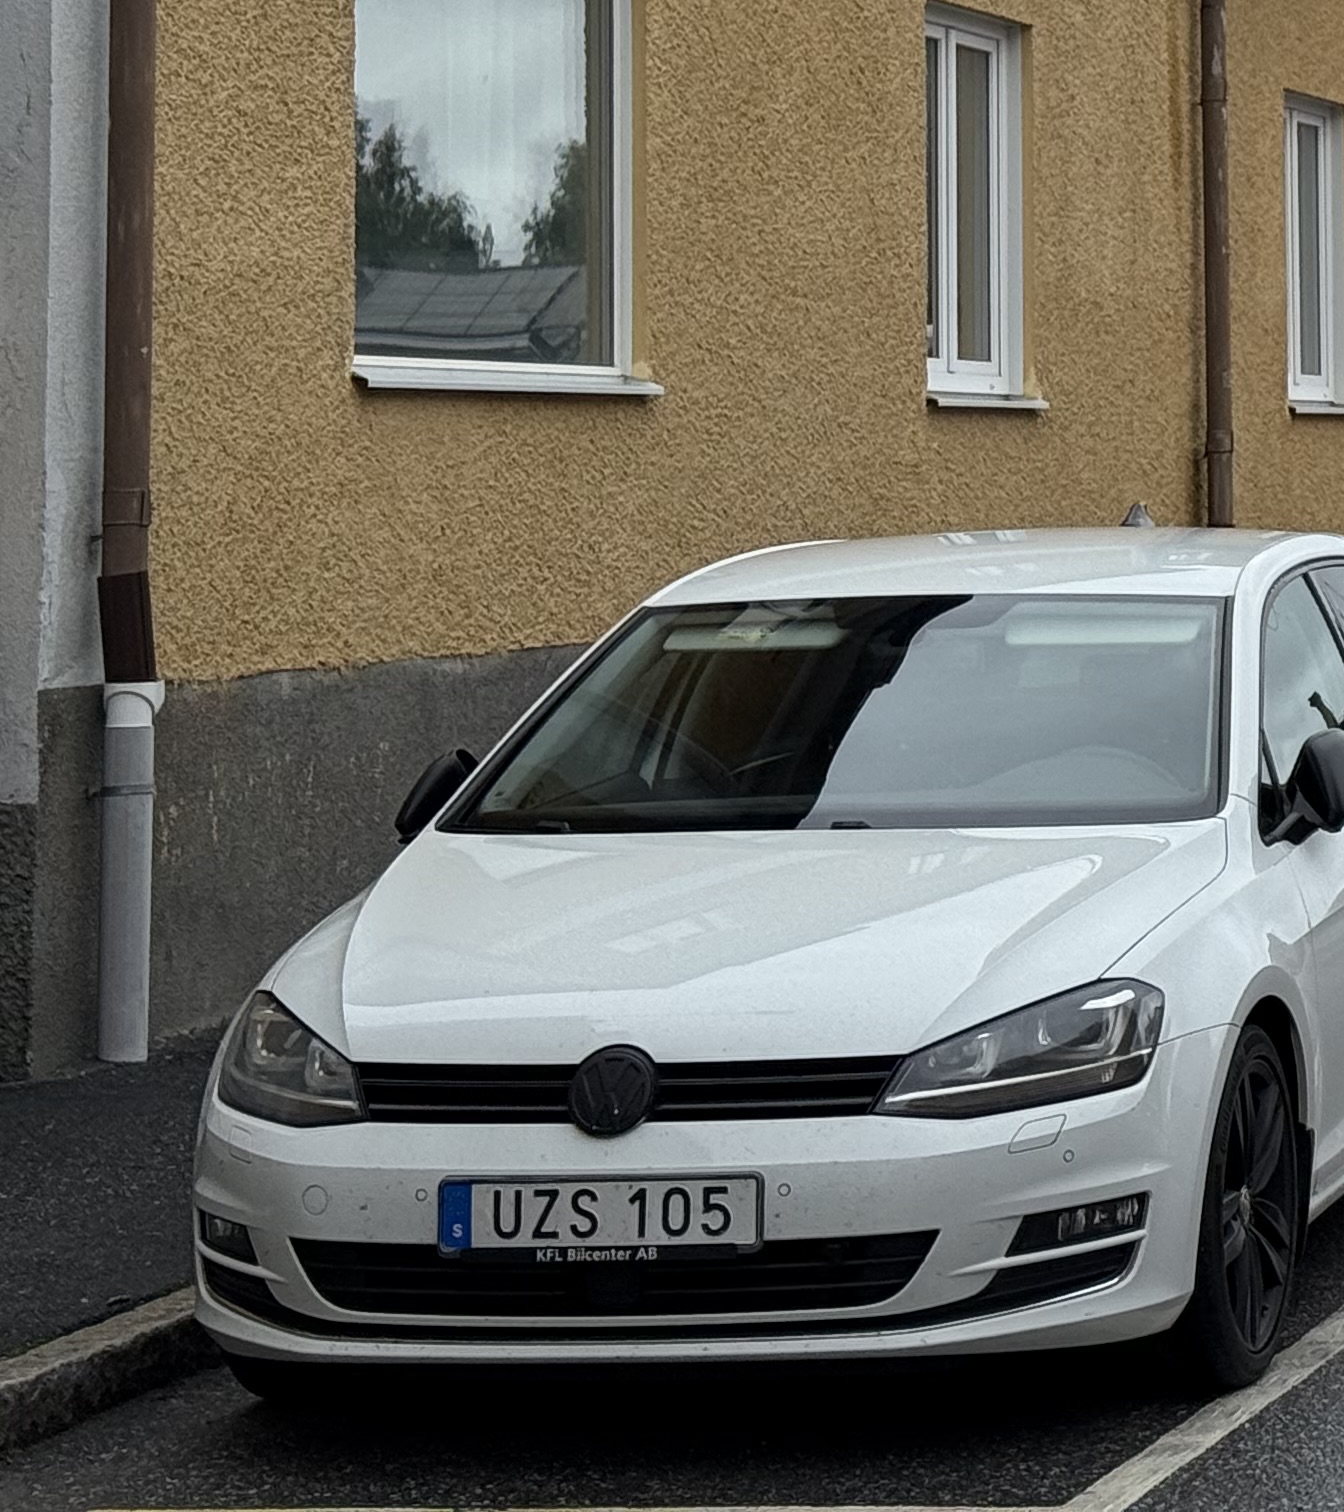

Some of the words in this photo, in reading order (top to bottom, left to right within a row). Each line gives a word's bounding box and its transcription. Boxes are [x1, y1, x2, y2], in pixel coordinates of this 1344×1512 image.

[493, 1188, 599, 1240] UZS
[628, 1186, 732, 1238] 105
[452, 1223, 463, 1239] S
[536, 1248, 563, 1262] KFL
[567, 1247, 632, 1261] Bilcenter
[635, 1246, 658, 1260] AB
